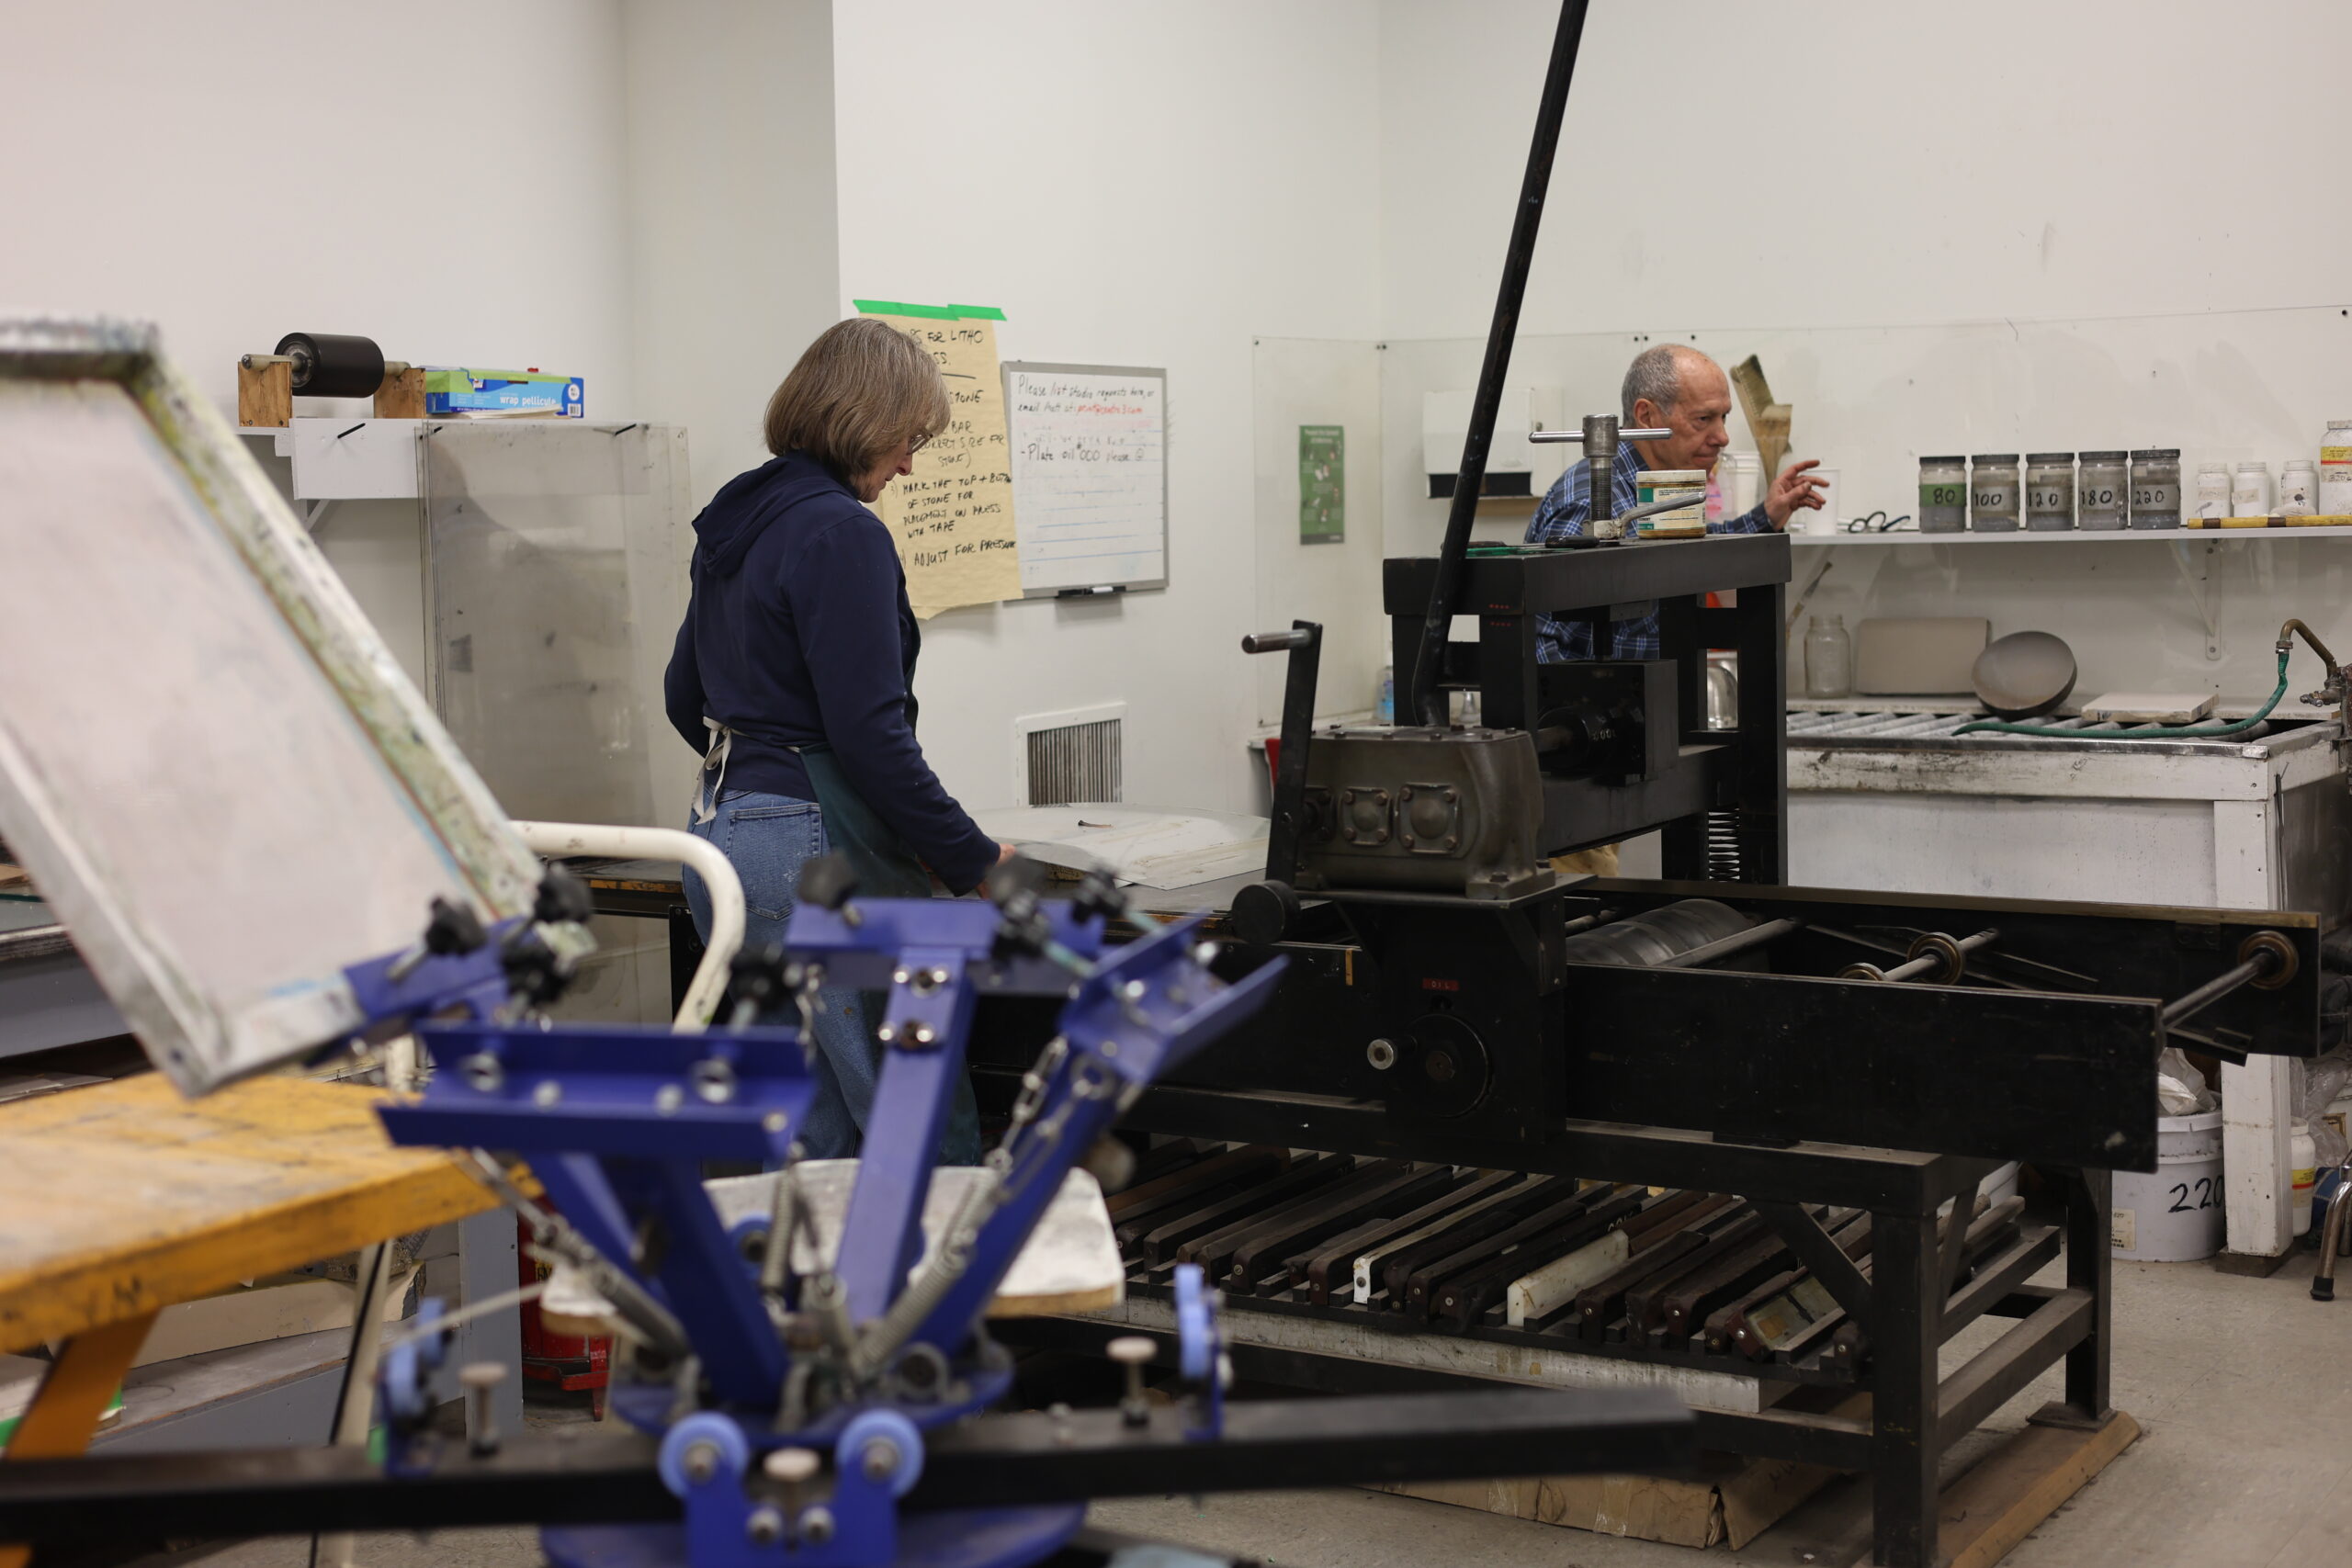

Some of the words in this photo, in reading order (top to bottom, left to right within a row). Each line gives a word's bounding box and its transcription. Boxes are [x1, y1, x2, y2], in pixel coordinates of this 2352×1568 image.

[951, 330, 984, 345] LITHO
[500, 396, 518, 405] wrap
[903, 482, 930, 495] MARK
[933, 479, 952, 489] THE
[959, 475, 977, 486] TOP
[908, 499, 918, 509] OF
[922, 493, 952, 506] STONE
[957, 491, 974, 501] FOR
[1933, 488, 1955, 504] 80
[1974, 493, 2002, 506] 100
[2028, 491, 2058, 506] 120
[2081, 490, 2113, 506] 180
[2135, 491, 2165, 505] 220
[929, 520, 956, 532] TAPE
[914, 550, 948, 566] ADJUST
[956, 544, 976, 556] FOR
[2168, 1175, 2224, 1213] 220
